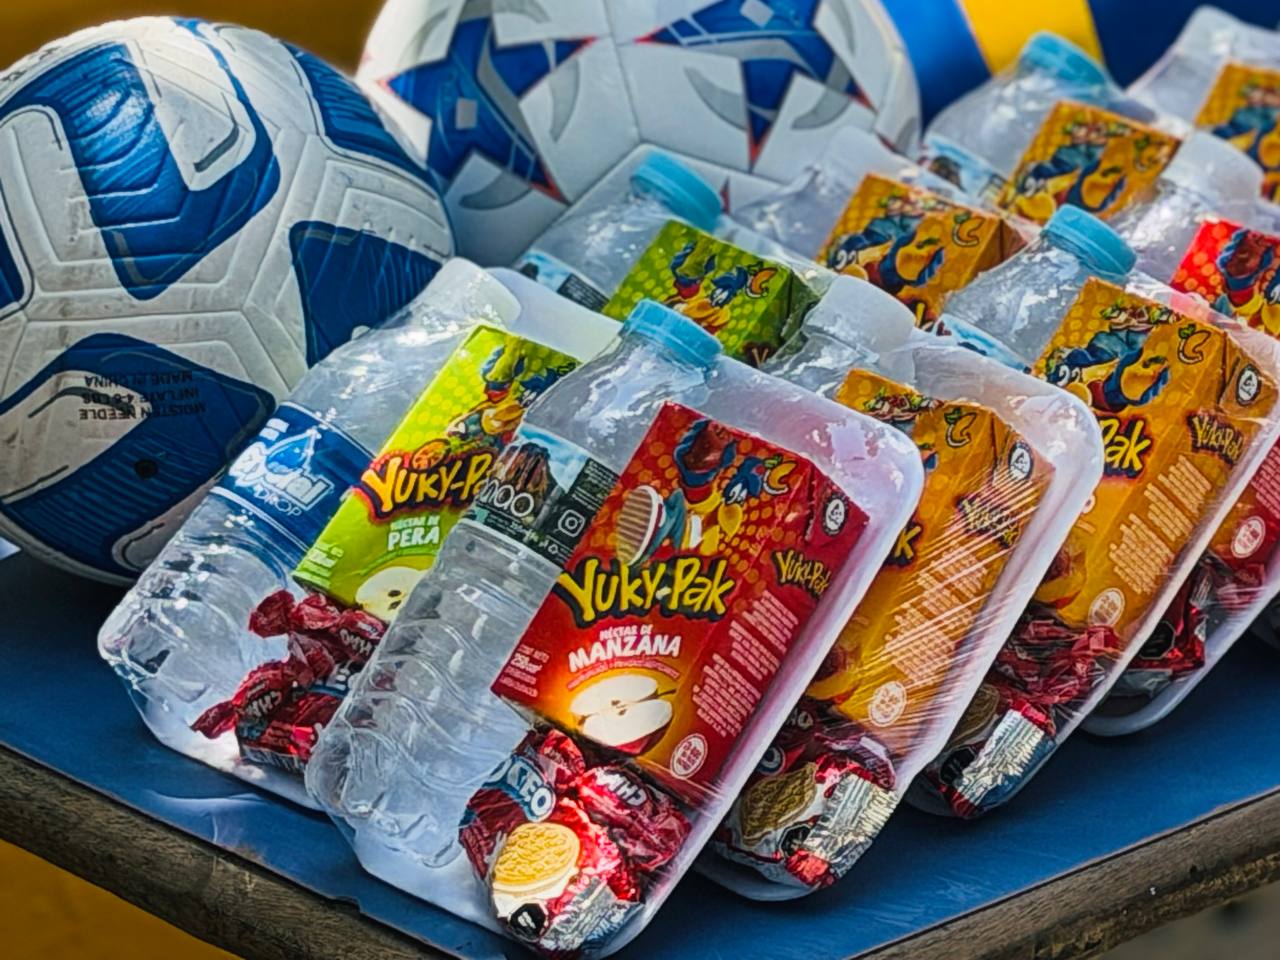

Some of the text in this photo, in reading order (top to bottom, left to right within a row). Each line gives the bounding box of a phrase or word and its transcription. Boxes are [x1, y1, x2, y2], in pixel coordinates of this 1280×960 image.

[79, 405, 136, 420] NEEDLE
[254, 489, 302, 517] DROP
[388, 525, 441, 551] PERA
[568, 634, 682, 673] MANZANA
